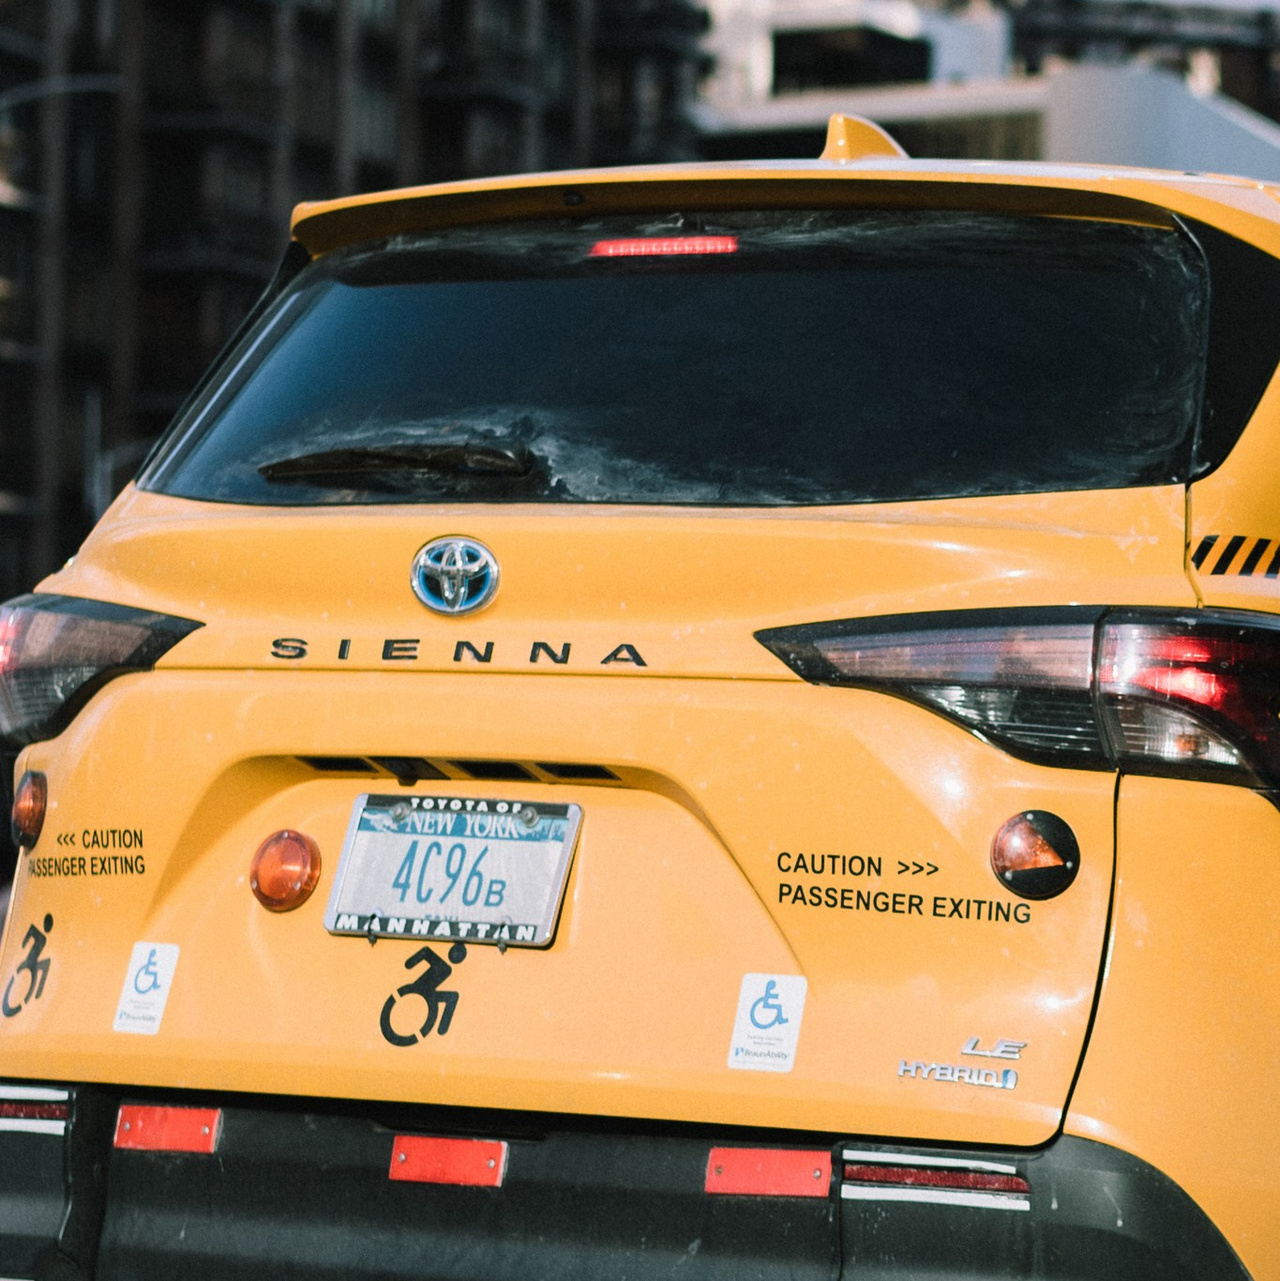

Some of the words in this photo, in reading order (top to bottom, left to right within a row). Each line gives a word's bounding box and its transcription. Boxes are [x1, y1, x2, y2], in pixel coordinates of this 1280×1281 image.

[271, 638, 648, 667] SIENNA
[411, 798, 488, 813] TOYOTA
[496, 802, 522, 813] OF
[82, 829, 143, 848] CAUTION
[406, 812, 459, 835] NEW
[464, 815, 519, 839] YORK
[91, 855, 145, 875] EXITING
[392, 840, 507, 907] 4C96B
[777, 852, 882, 876] CAUTION
[778, 883, 923, 915] PASSENGER
[932, 897, 1031, 924] EXITING
[337, 915, 534, 941] MANHATTAN
[961, 1036, 1028, 1060] LE
[897, 1060, 1004, 1089] HYBRID
